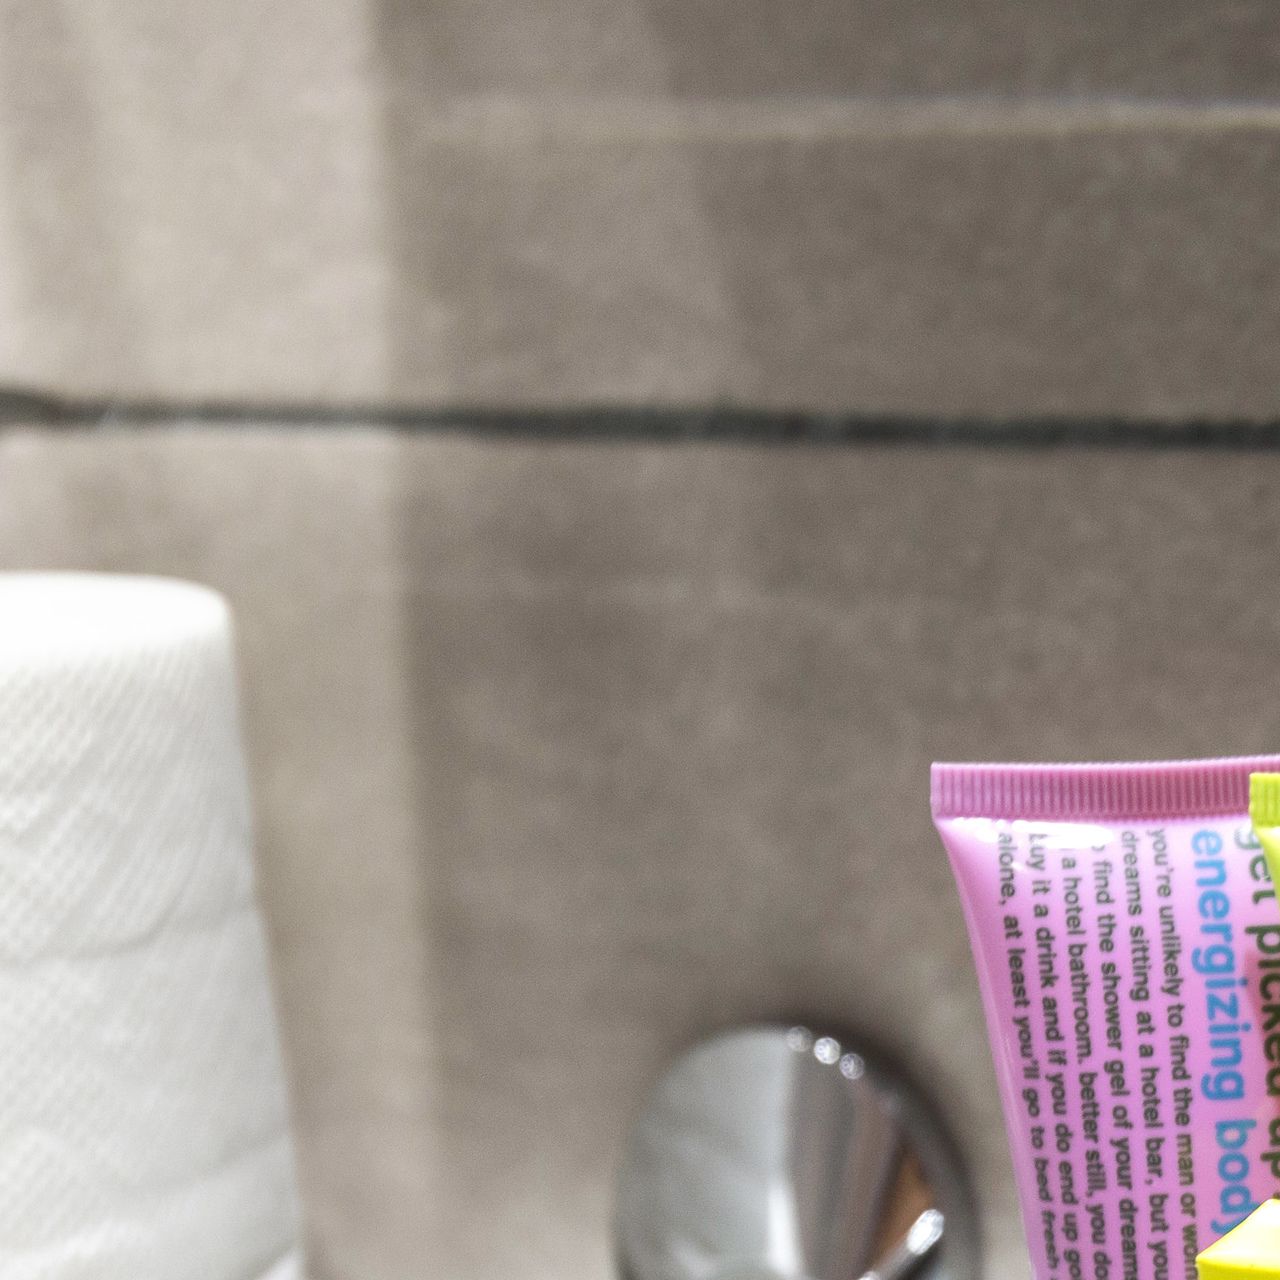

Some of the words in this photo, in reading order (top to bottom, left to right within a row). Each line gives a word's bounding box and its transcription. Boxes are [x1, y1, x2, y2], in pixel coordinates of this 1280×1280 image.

[1122, 832, 1143, 916] dreams
[1129, 926, 1151, 1002] sitting
[1193, 832, 1251, 1100] energizing
[1136, 1011, 1155, 1034] at
[1139, 1044, 1154, 1058] a
[1141, 1067, 1164, 1128] hotel
[1145, 1137, 1165, 1185] bar,
[1149, 1194, 1169, 1232] but
